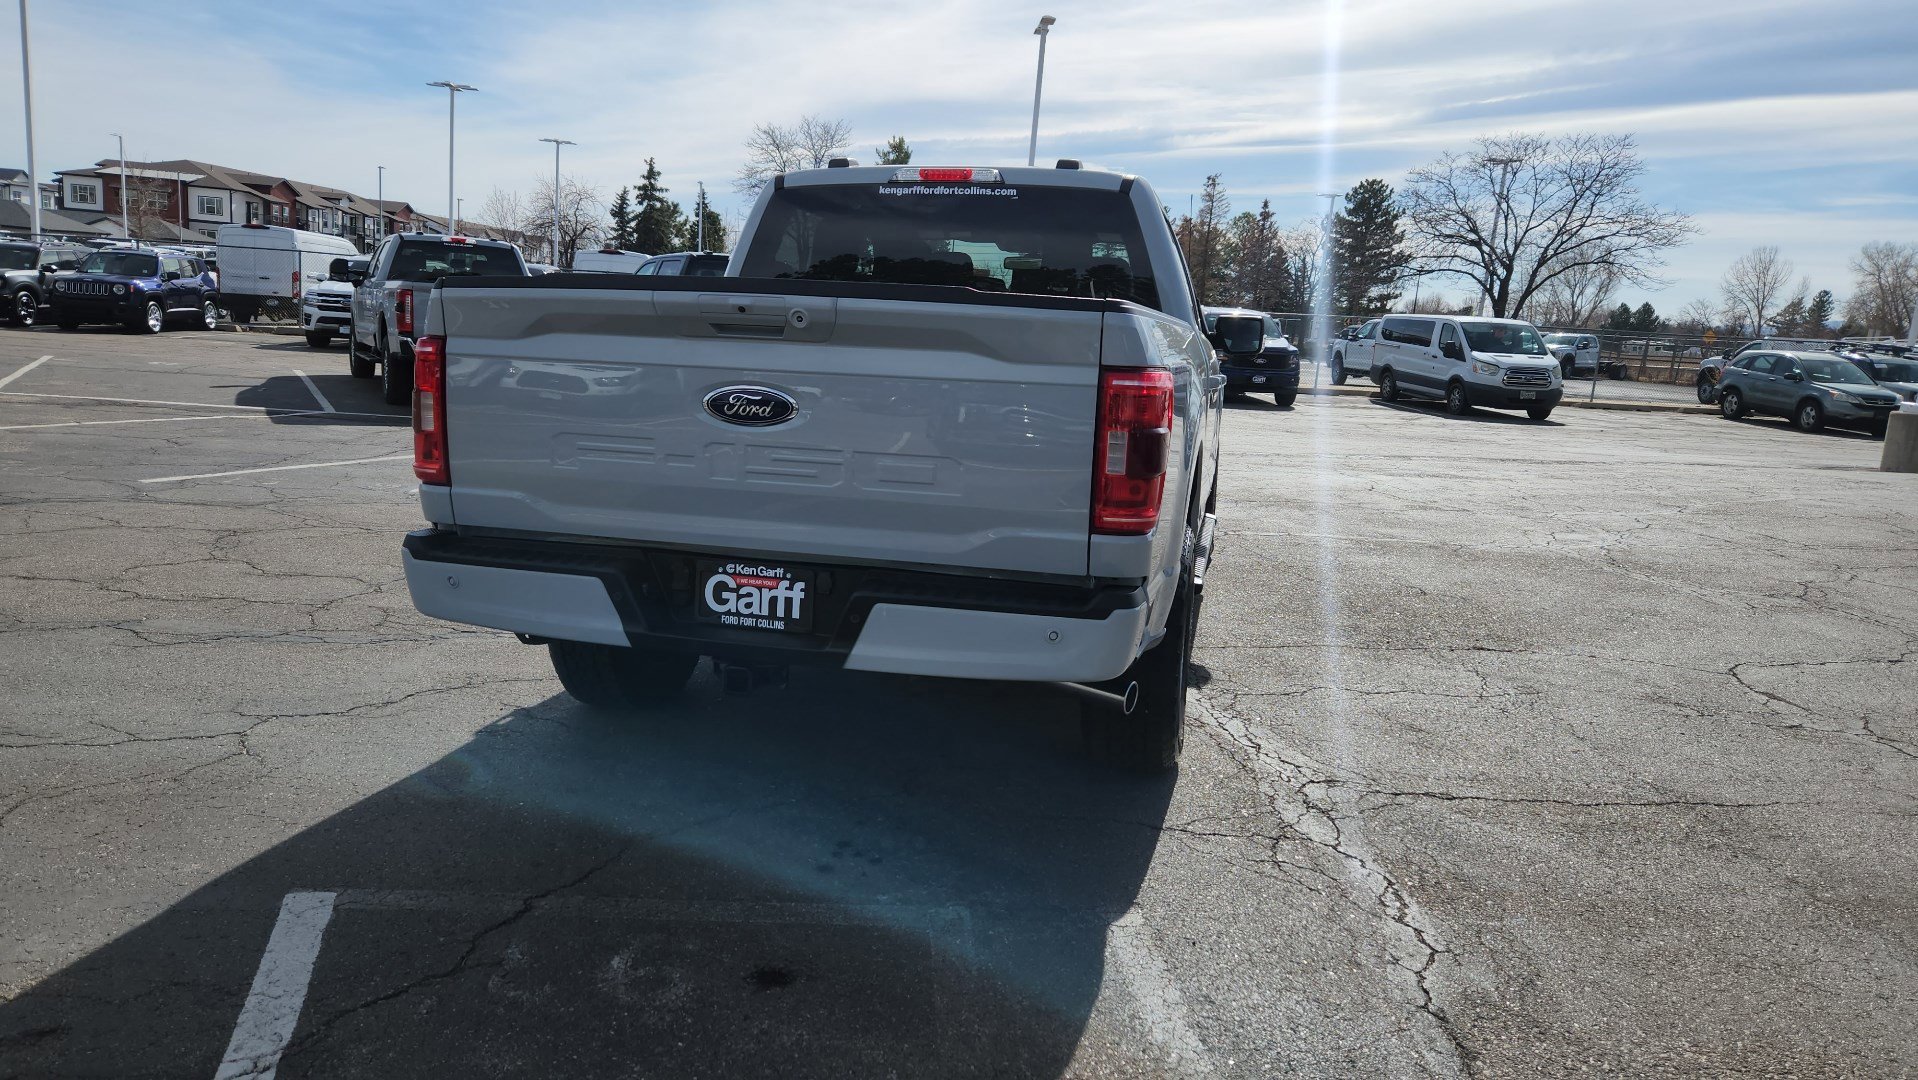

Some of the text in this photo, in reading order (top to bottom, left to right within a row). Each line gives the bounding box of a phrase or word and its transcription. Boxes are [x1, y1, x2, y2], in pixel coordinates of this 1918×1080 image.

[724, 393, 775, 418] Ford
[551, 431, 965, 497] F-150
[735, 563, 785, 578] Ken Garff
[704, 573, 806, 620] Garff
[721, 614, 785, 630] FORD FORT COLLINS
